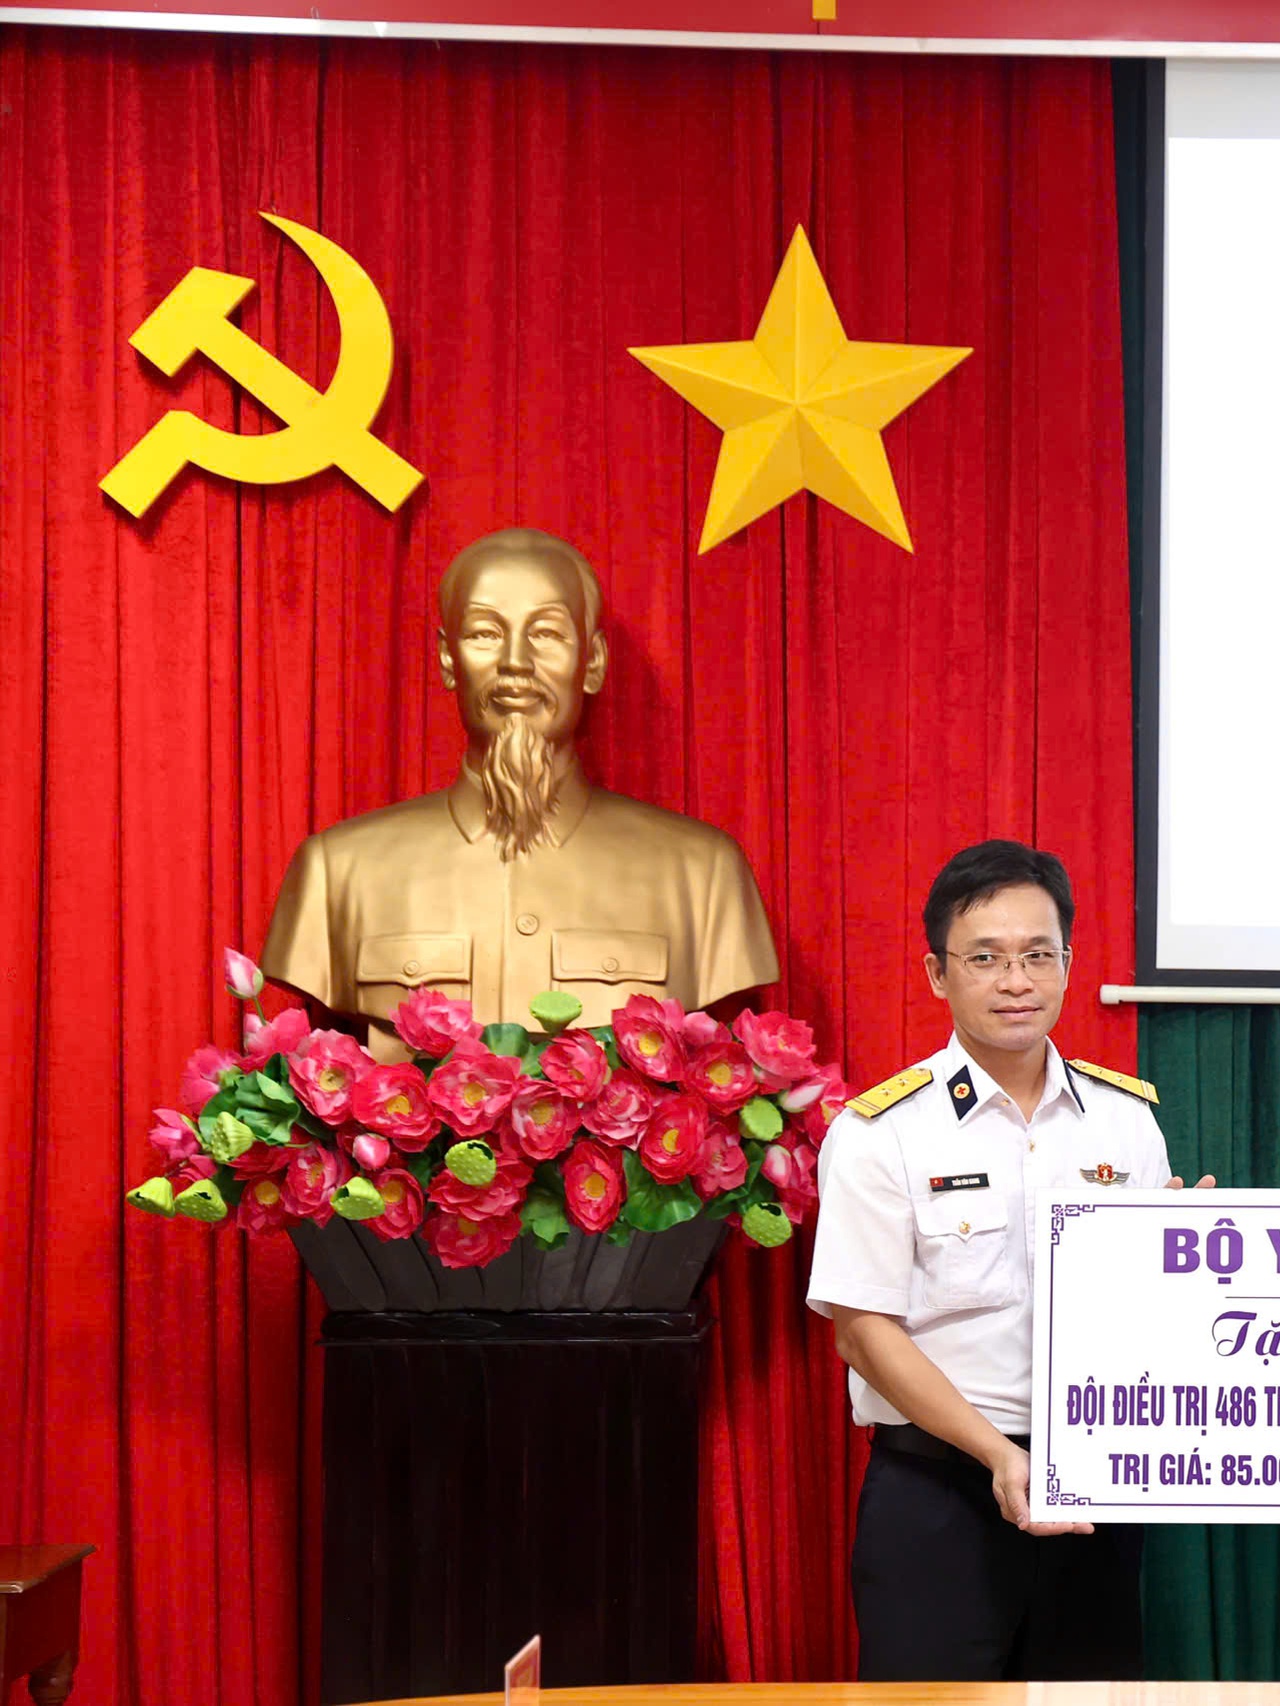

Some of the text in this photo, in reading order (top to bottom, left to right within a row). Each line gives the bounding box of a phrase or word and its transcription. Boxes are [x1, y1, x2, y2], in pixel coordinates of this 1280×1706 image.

[1163, 1218, 1243, 1284] BỘ
[1067, 1376, 1105, 1435] ĐỘI
[1113, 1371, 1165, 1426] ĐIỀU
[1173, 1386, 1207, 1436] TRỊ
[1215, 1386, 1256, 1427] 486
[1109, 1454, 1149, 1492] TRỊ
[1159, 1447, 1211, 1485] GIÁ:
